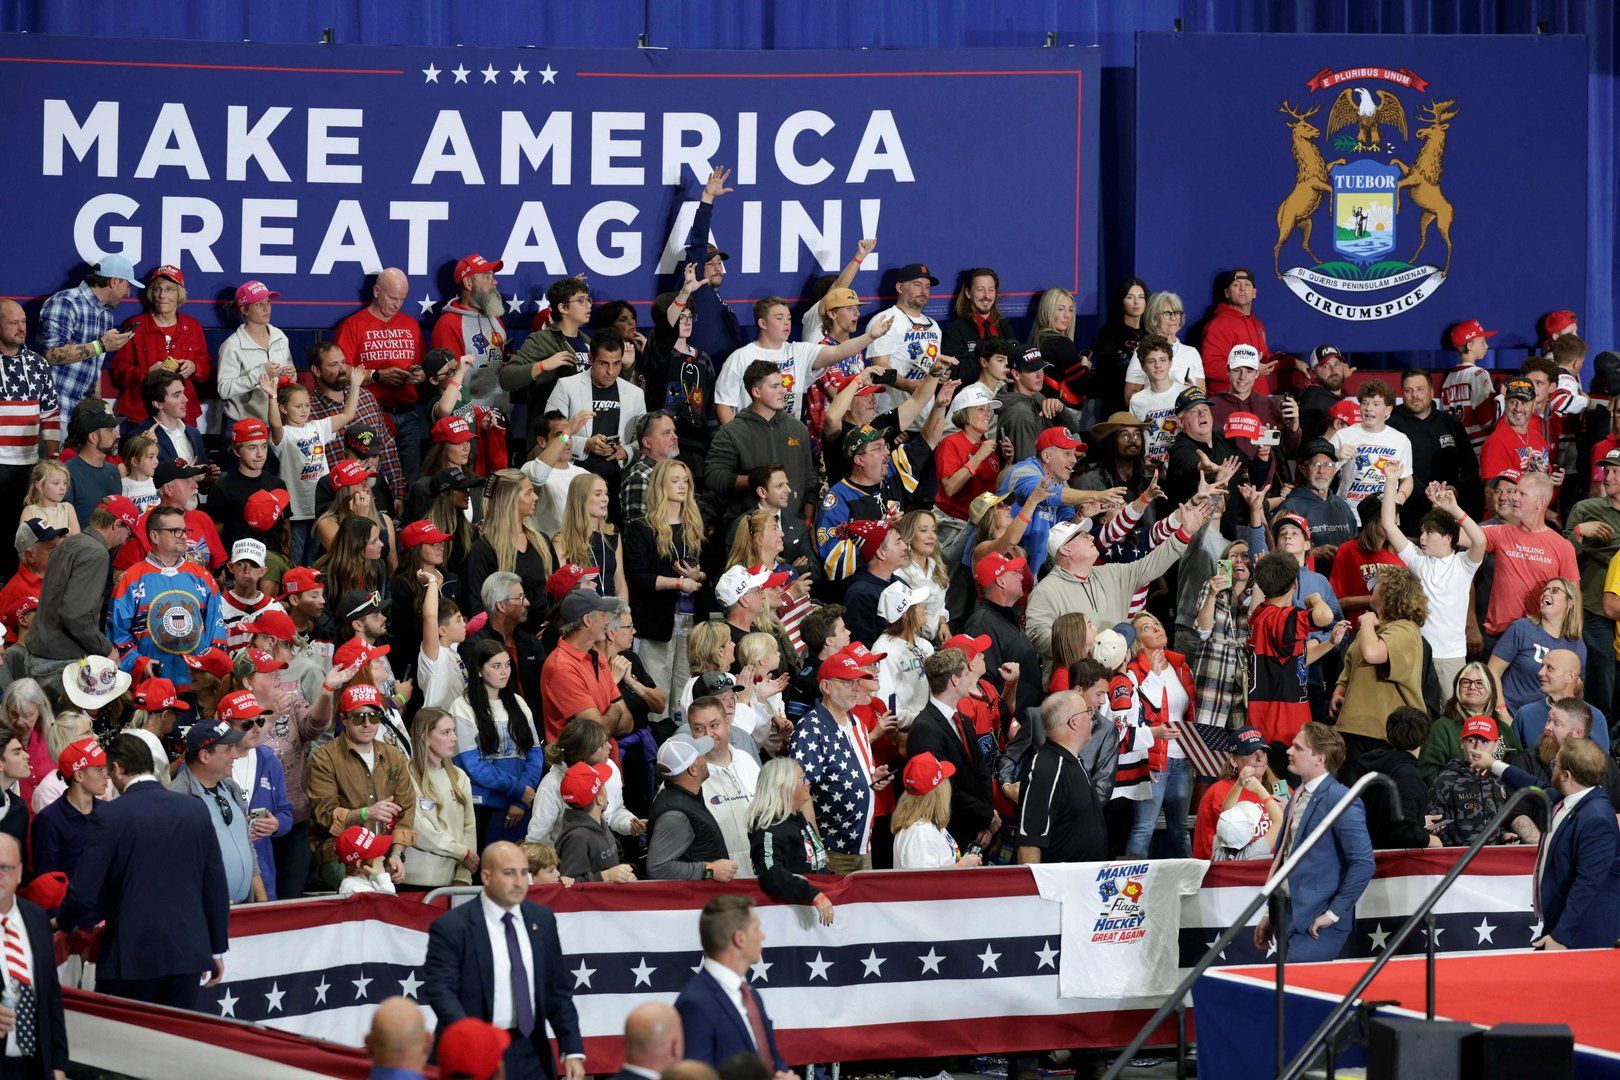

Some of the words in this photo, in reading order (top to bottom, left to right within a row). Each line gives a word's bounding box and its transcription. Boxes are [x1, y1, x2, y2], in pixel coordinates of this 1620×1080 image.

[1323, 79, 1330, 87] E
[1334, 68, 1379, 81] PLURIBUS
[1384, 70, 1410, 84] UNUM
[43, 100, 363, 183] MAKE
[412, 109, 916, 186] AMERICA
[1335, 175, 1396, 189] TUEBOR
[74, 194, 449, 276] GREAT
[494, 198, 881, 277] AGAIN!
[1297, 268, 1306, 277] SI
[1342, 280, 1389, 290] PENINSULAM
[1305, 288, 1425, 318] CIRCUMSPICE
[365, 328, 413, 340] TRUMP'S
[363, 339, 415, 351] FAVORITE
[360, 350, 416, 362] FIREFIGHTE
[1022, 350, 1042, 361] TRUM
[1233, 350, 1256, 358] TRUMP
[1145, 408, 1176, 419] MAKIN
[1229, 416, 1240, 424] MAKE
[1241, 417, 1258, 427] AMERICA
[1244, 424, 1257, 432] AGAIN
[1356, 446, 1397, 457] MAKING
[1349, 481, 1384, 492] HOCKE
[132, 494, 160, 505] MAKING
[1309, 523, 1351, 534] carhartt
[248, 542, 265, 552] AMERICA
[251, 549, 264, 557] AGAIN
[1506, 550, 1528, 560] GREAT
[1529, 553, 1553, 564] AGAIN
[735, 580, 748, 595] 45-47
[16, 603, 29, 617] 45-47
[896, 598, 908, 614] 45-47
[349, 685, 378, 696] TRUMP
[1238, 730, 1262, 742] TRUMP
[72, 756, 89, 771] 45-47
[591, 777, 602, 795] 45-47
[710, 792, 756, 806] Champi
[1096, 864, 1150, 881] MAKING
[1111, 898, 1140, 913] Flags
[1093, 916, 1146, 932] HOCKEY
[1092, 931, 1118, 943] GREAT
[1119, 930, 1146, 941] AGAIN
